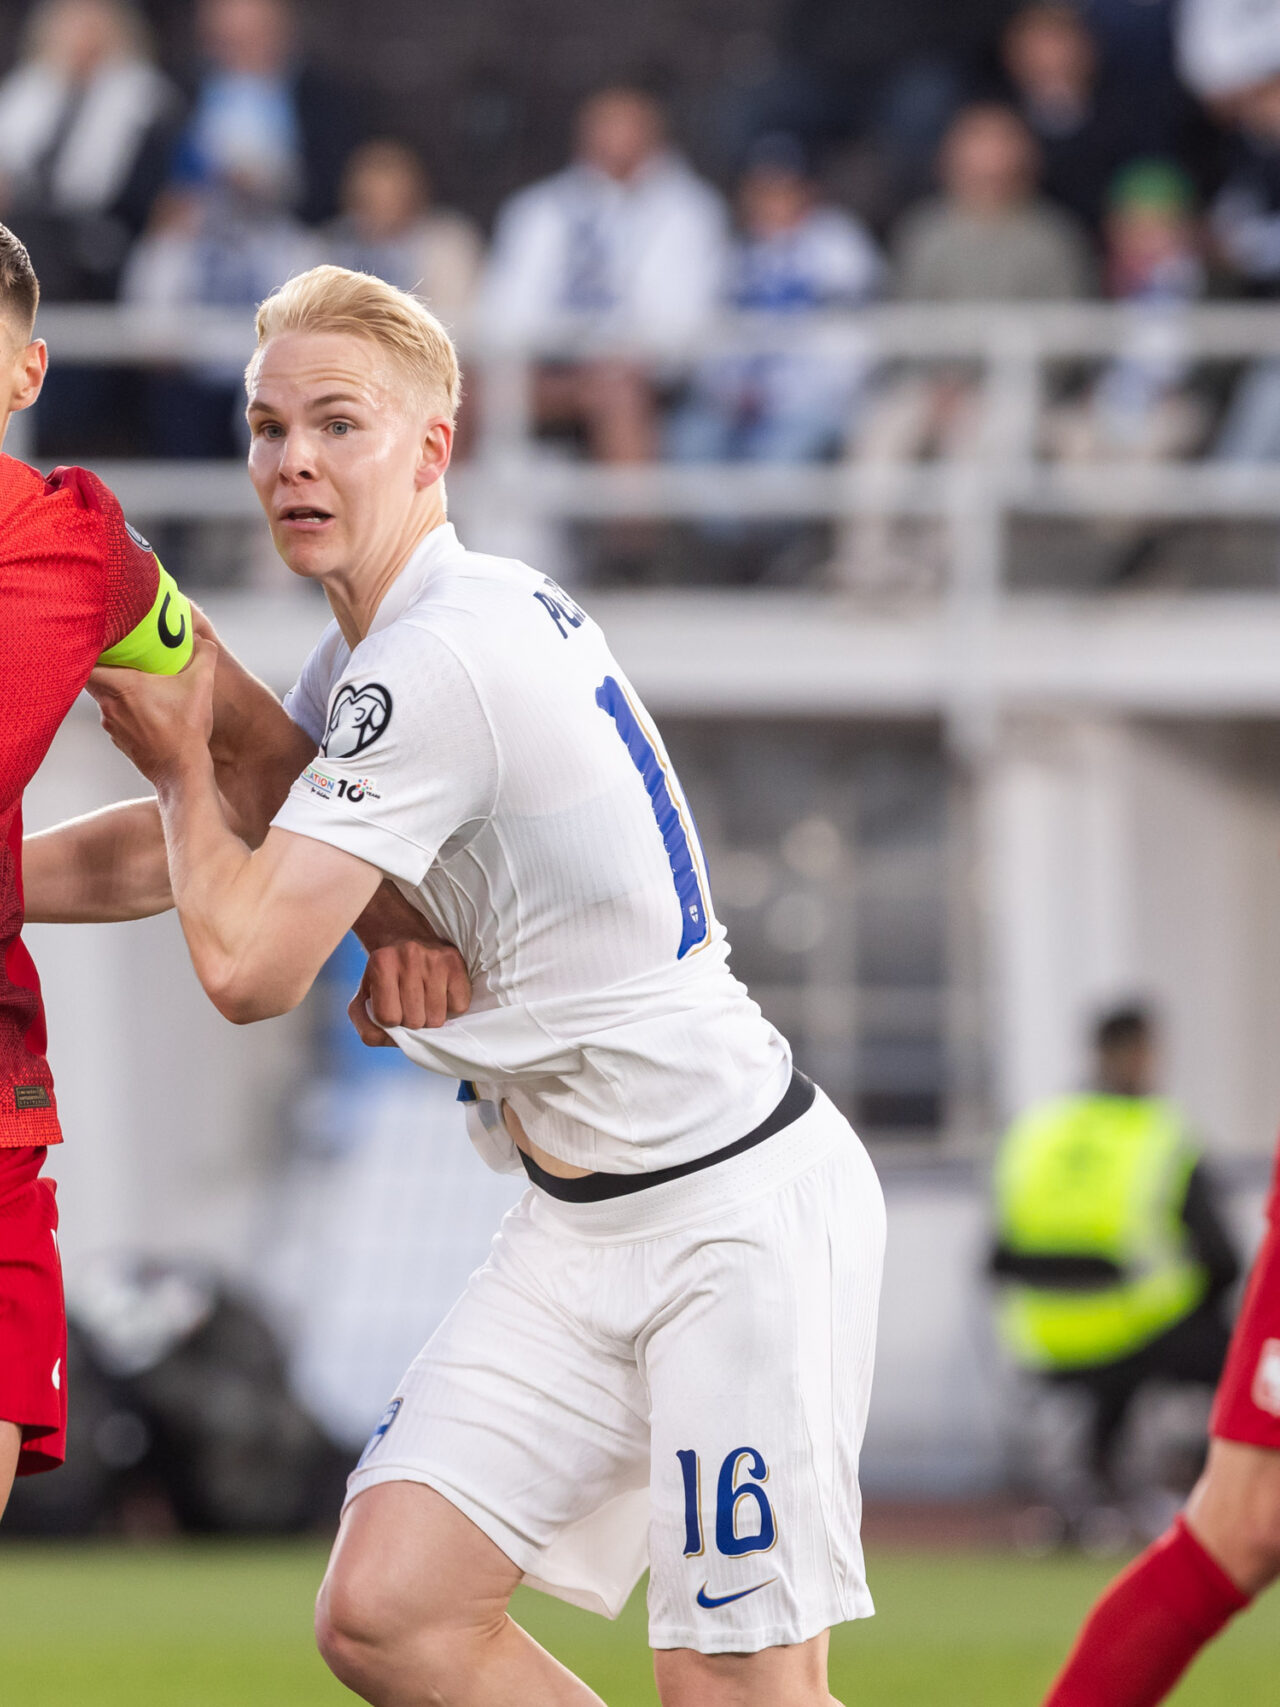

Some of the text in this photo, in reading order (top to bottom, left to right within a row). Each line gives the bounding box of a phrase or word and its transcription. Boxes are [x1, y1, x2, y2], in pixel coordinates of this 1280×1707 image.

[157, 591, 186, 649] C
[337, 779, 365, 803] 10
[676, 1446, 779, 1559] 16
